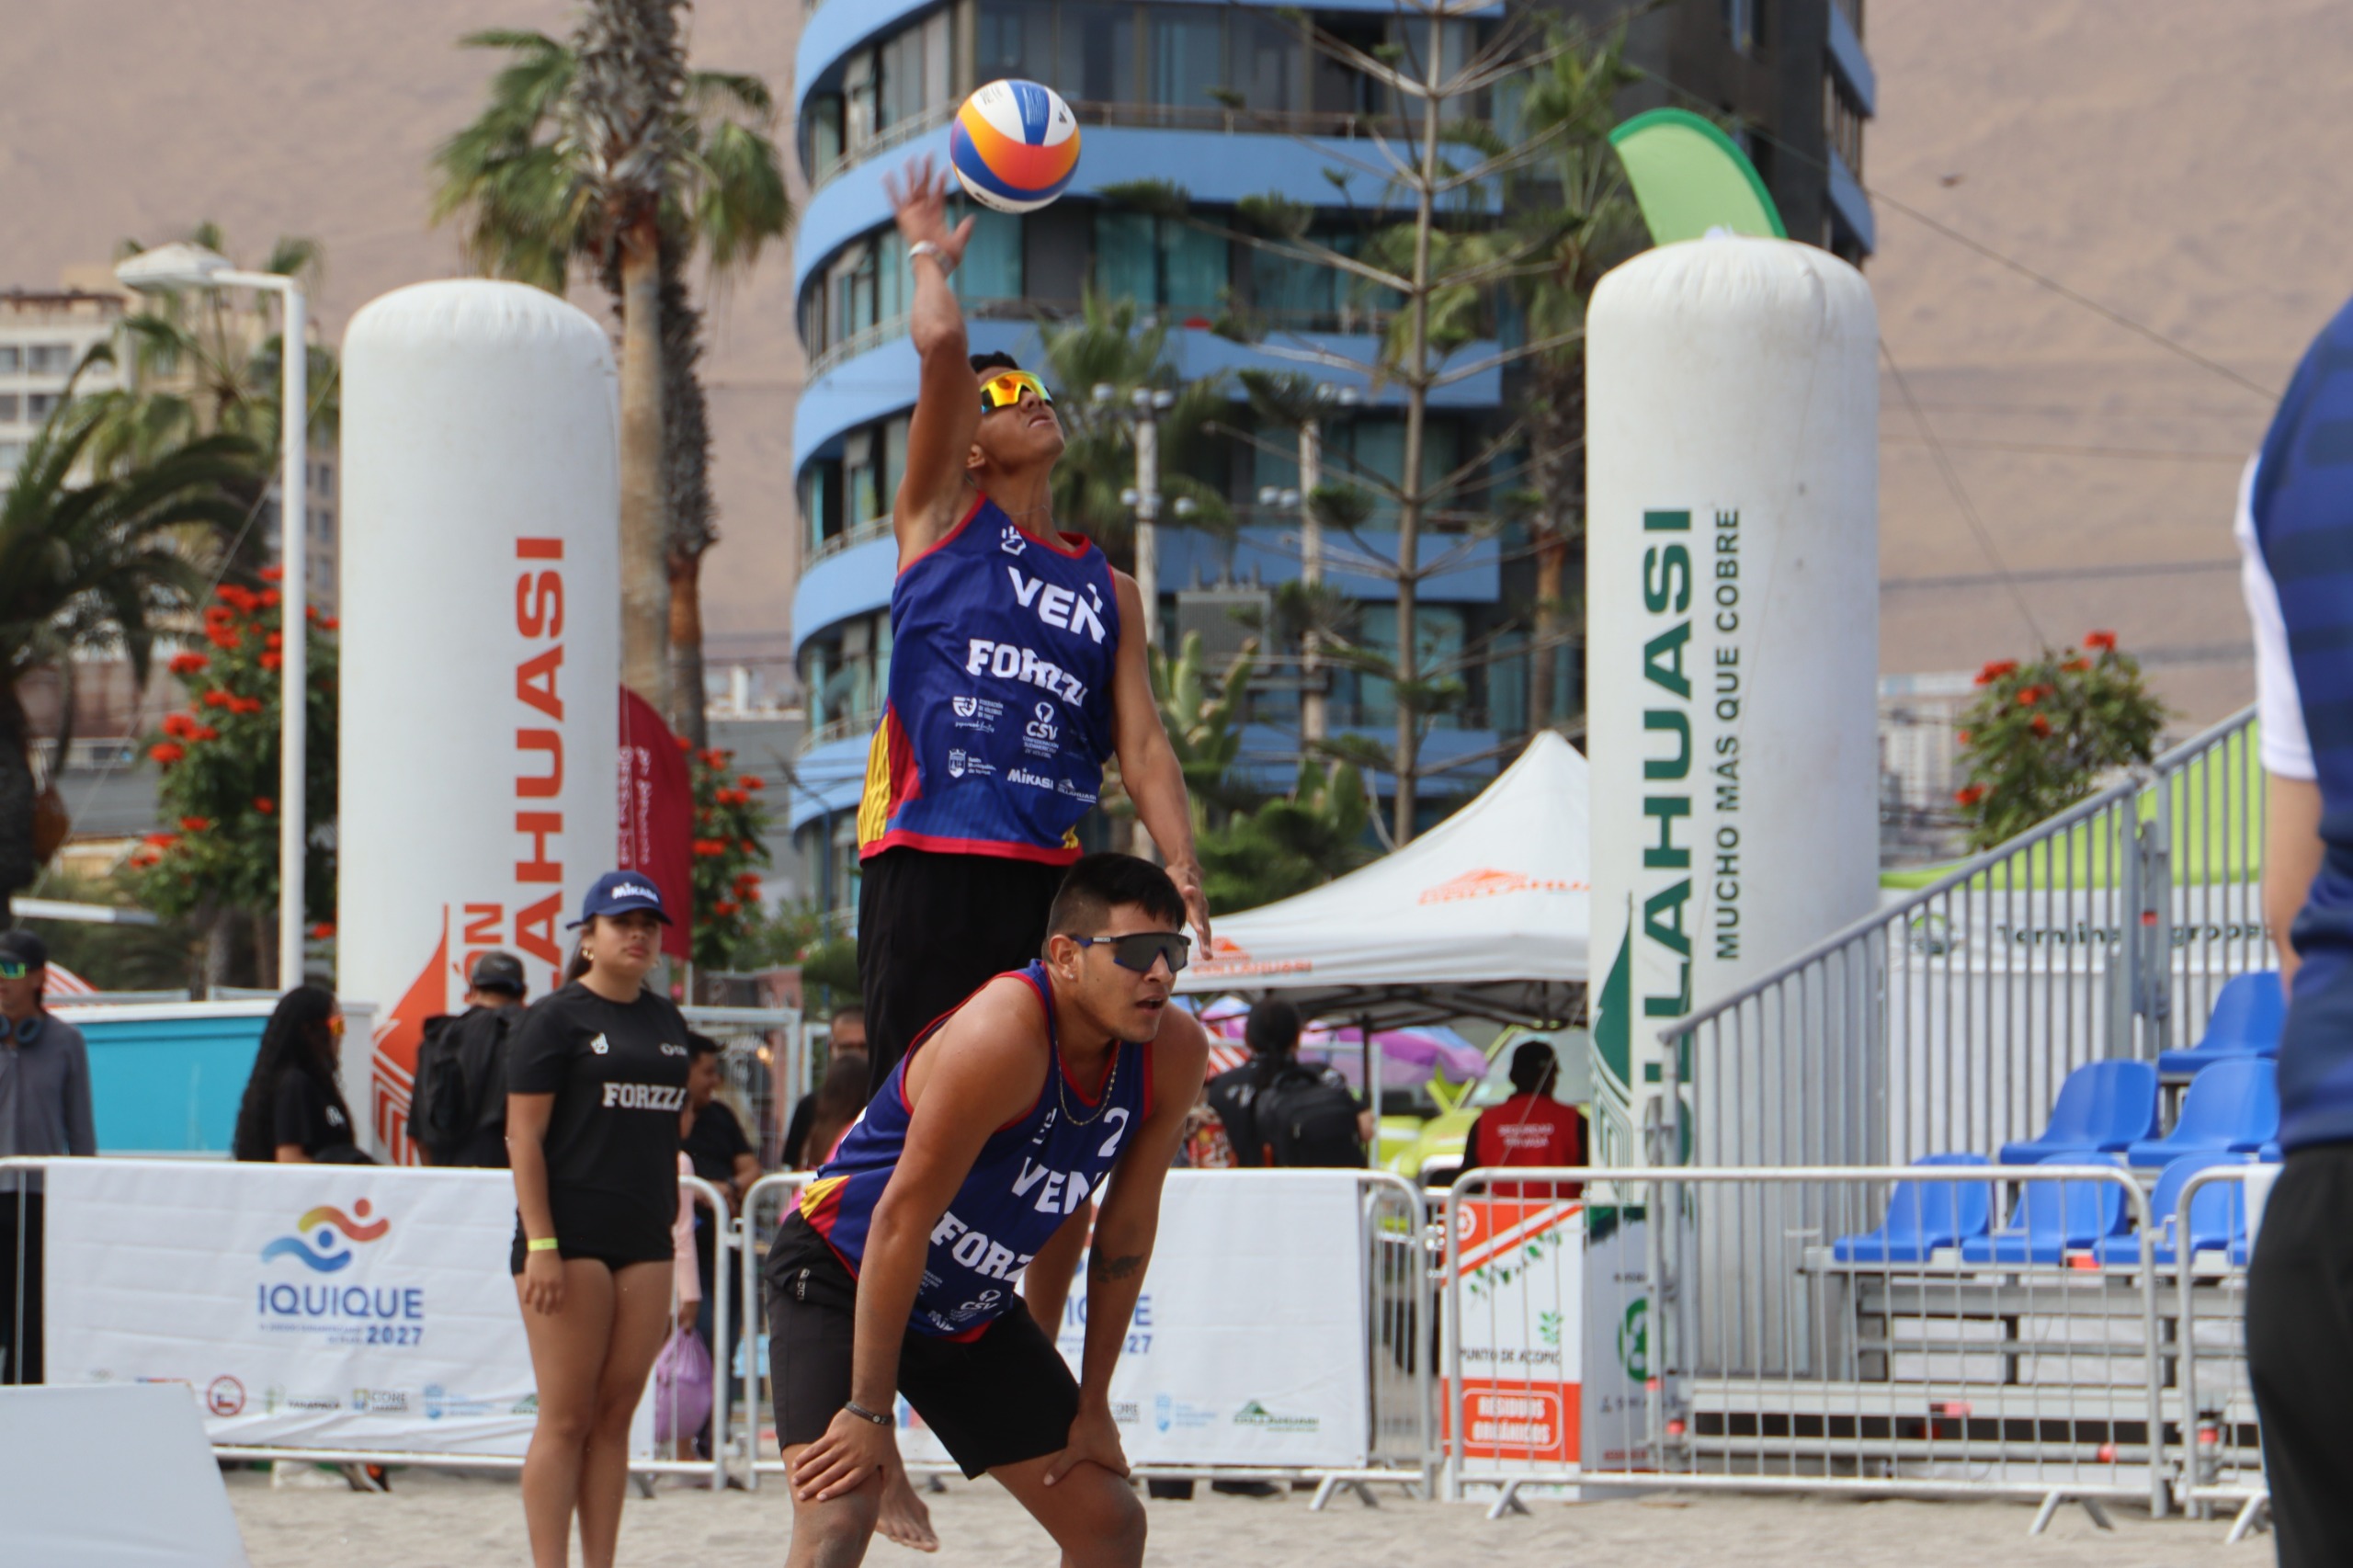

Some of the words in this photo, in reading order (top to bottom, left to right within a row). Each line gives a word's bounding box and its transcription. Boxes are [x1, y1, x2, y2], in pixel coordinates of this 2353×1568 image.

[1007, 565, 1106, 644] VEN
[1715, 510, 1739, 633] COBRE
[1715, 647, 1739, 722] QUE
[515, 538, 564, 991] AHUASI
[1026, 721, 1059, 741] CSV
[1710, 735, 1739, 812] MÁS
[1715, 826, 1739, 960] MUCHO
[1097, 1107, 1130, 1157] 2
[1011, 1156, 1103, 1215] VEN
[258, 1285, 424, 1319] IQUIQUE
[368, 1325, 424, 1346] 2027
[1500, 1348, 1515, 1362] DE
